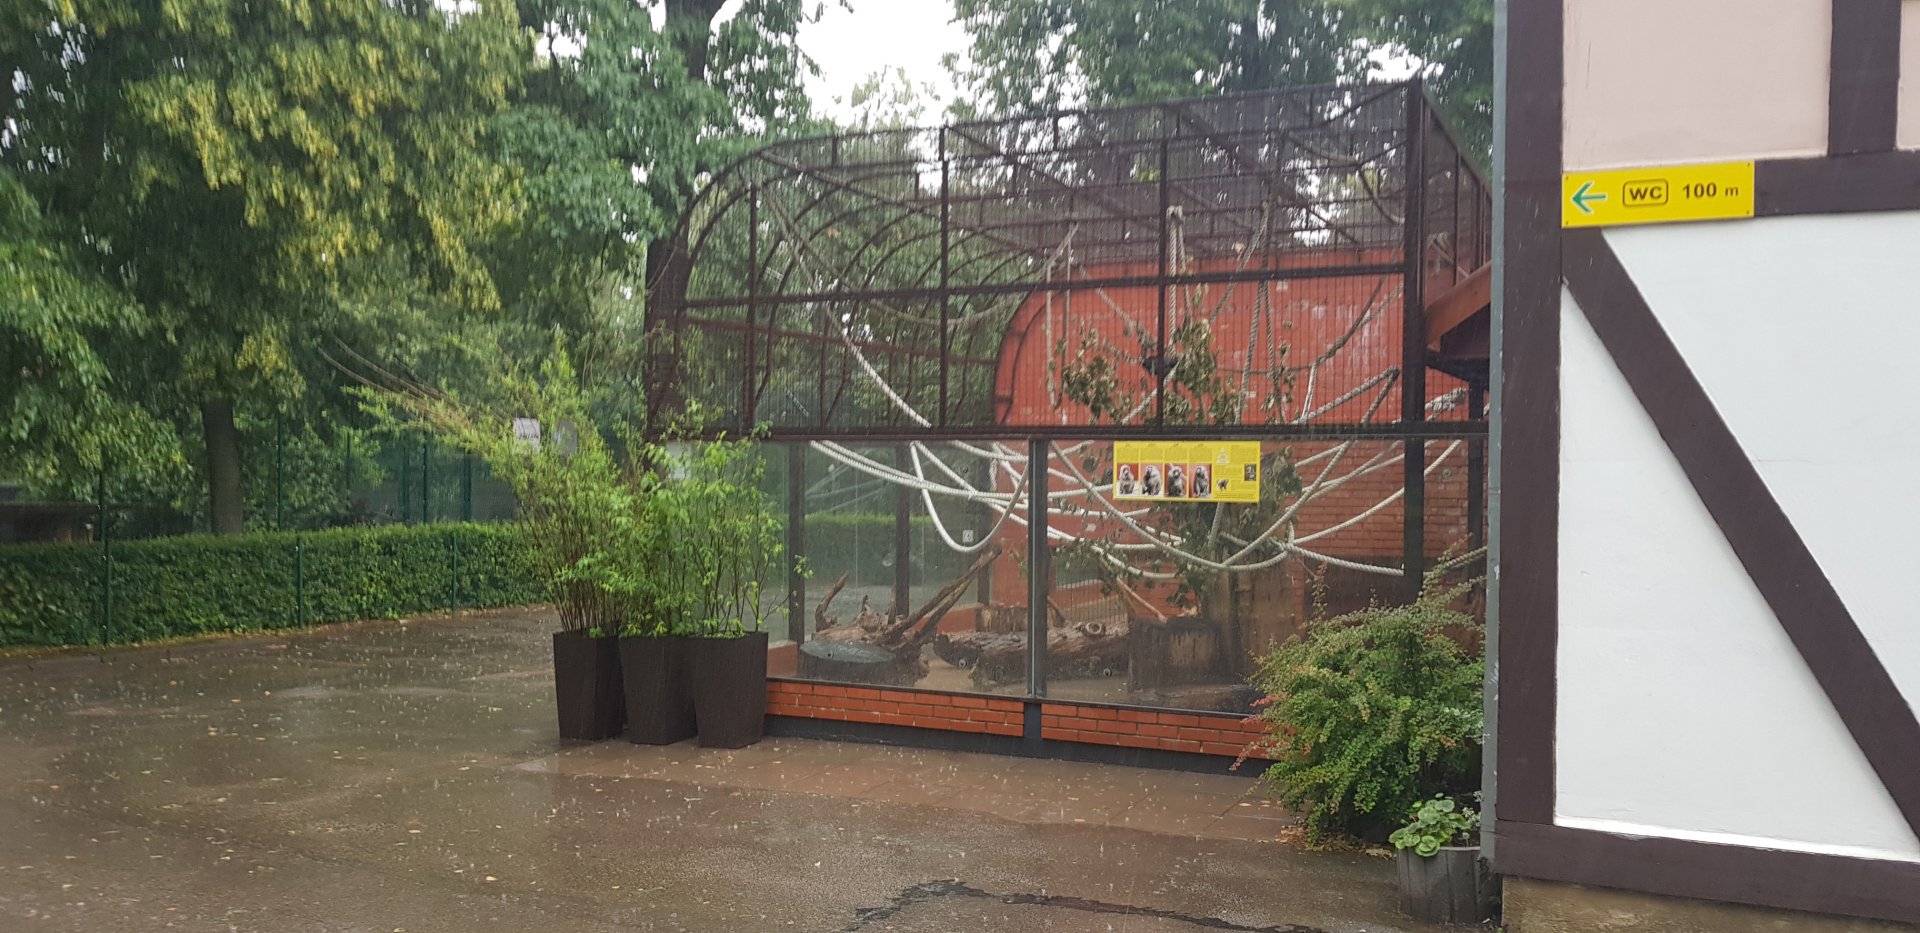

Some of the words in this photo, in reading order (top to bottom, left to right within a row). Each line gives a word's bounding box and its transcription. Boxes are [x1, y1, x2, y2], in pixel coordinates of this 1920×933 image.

[1629, 186, 1662, 201] WC
[1682, 182, 1717, 199] 100
[1725, 187, 1739, 197] m
